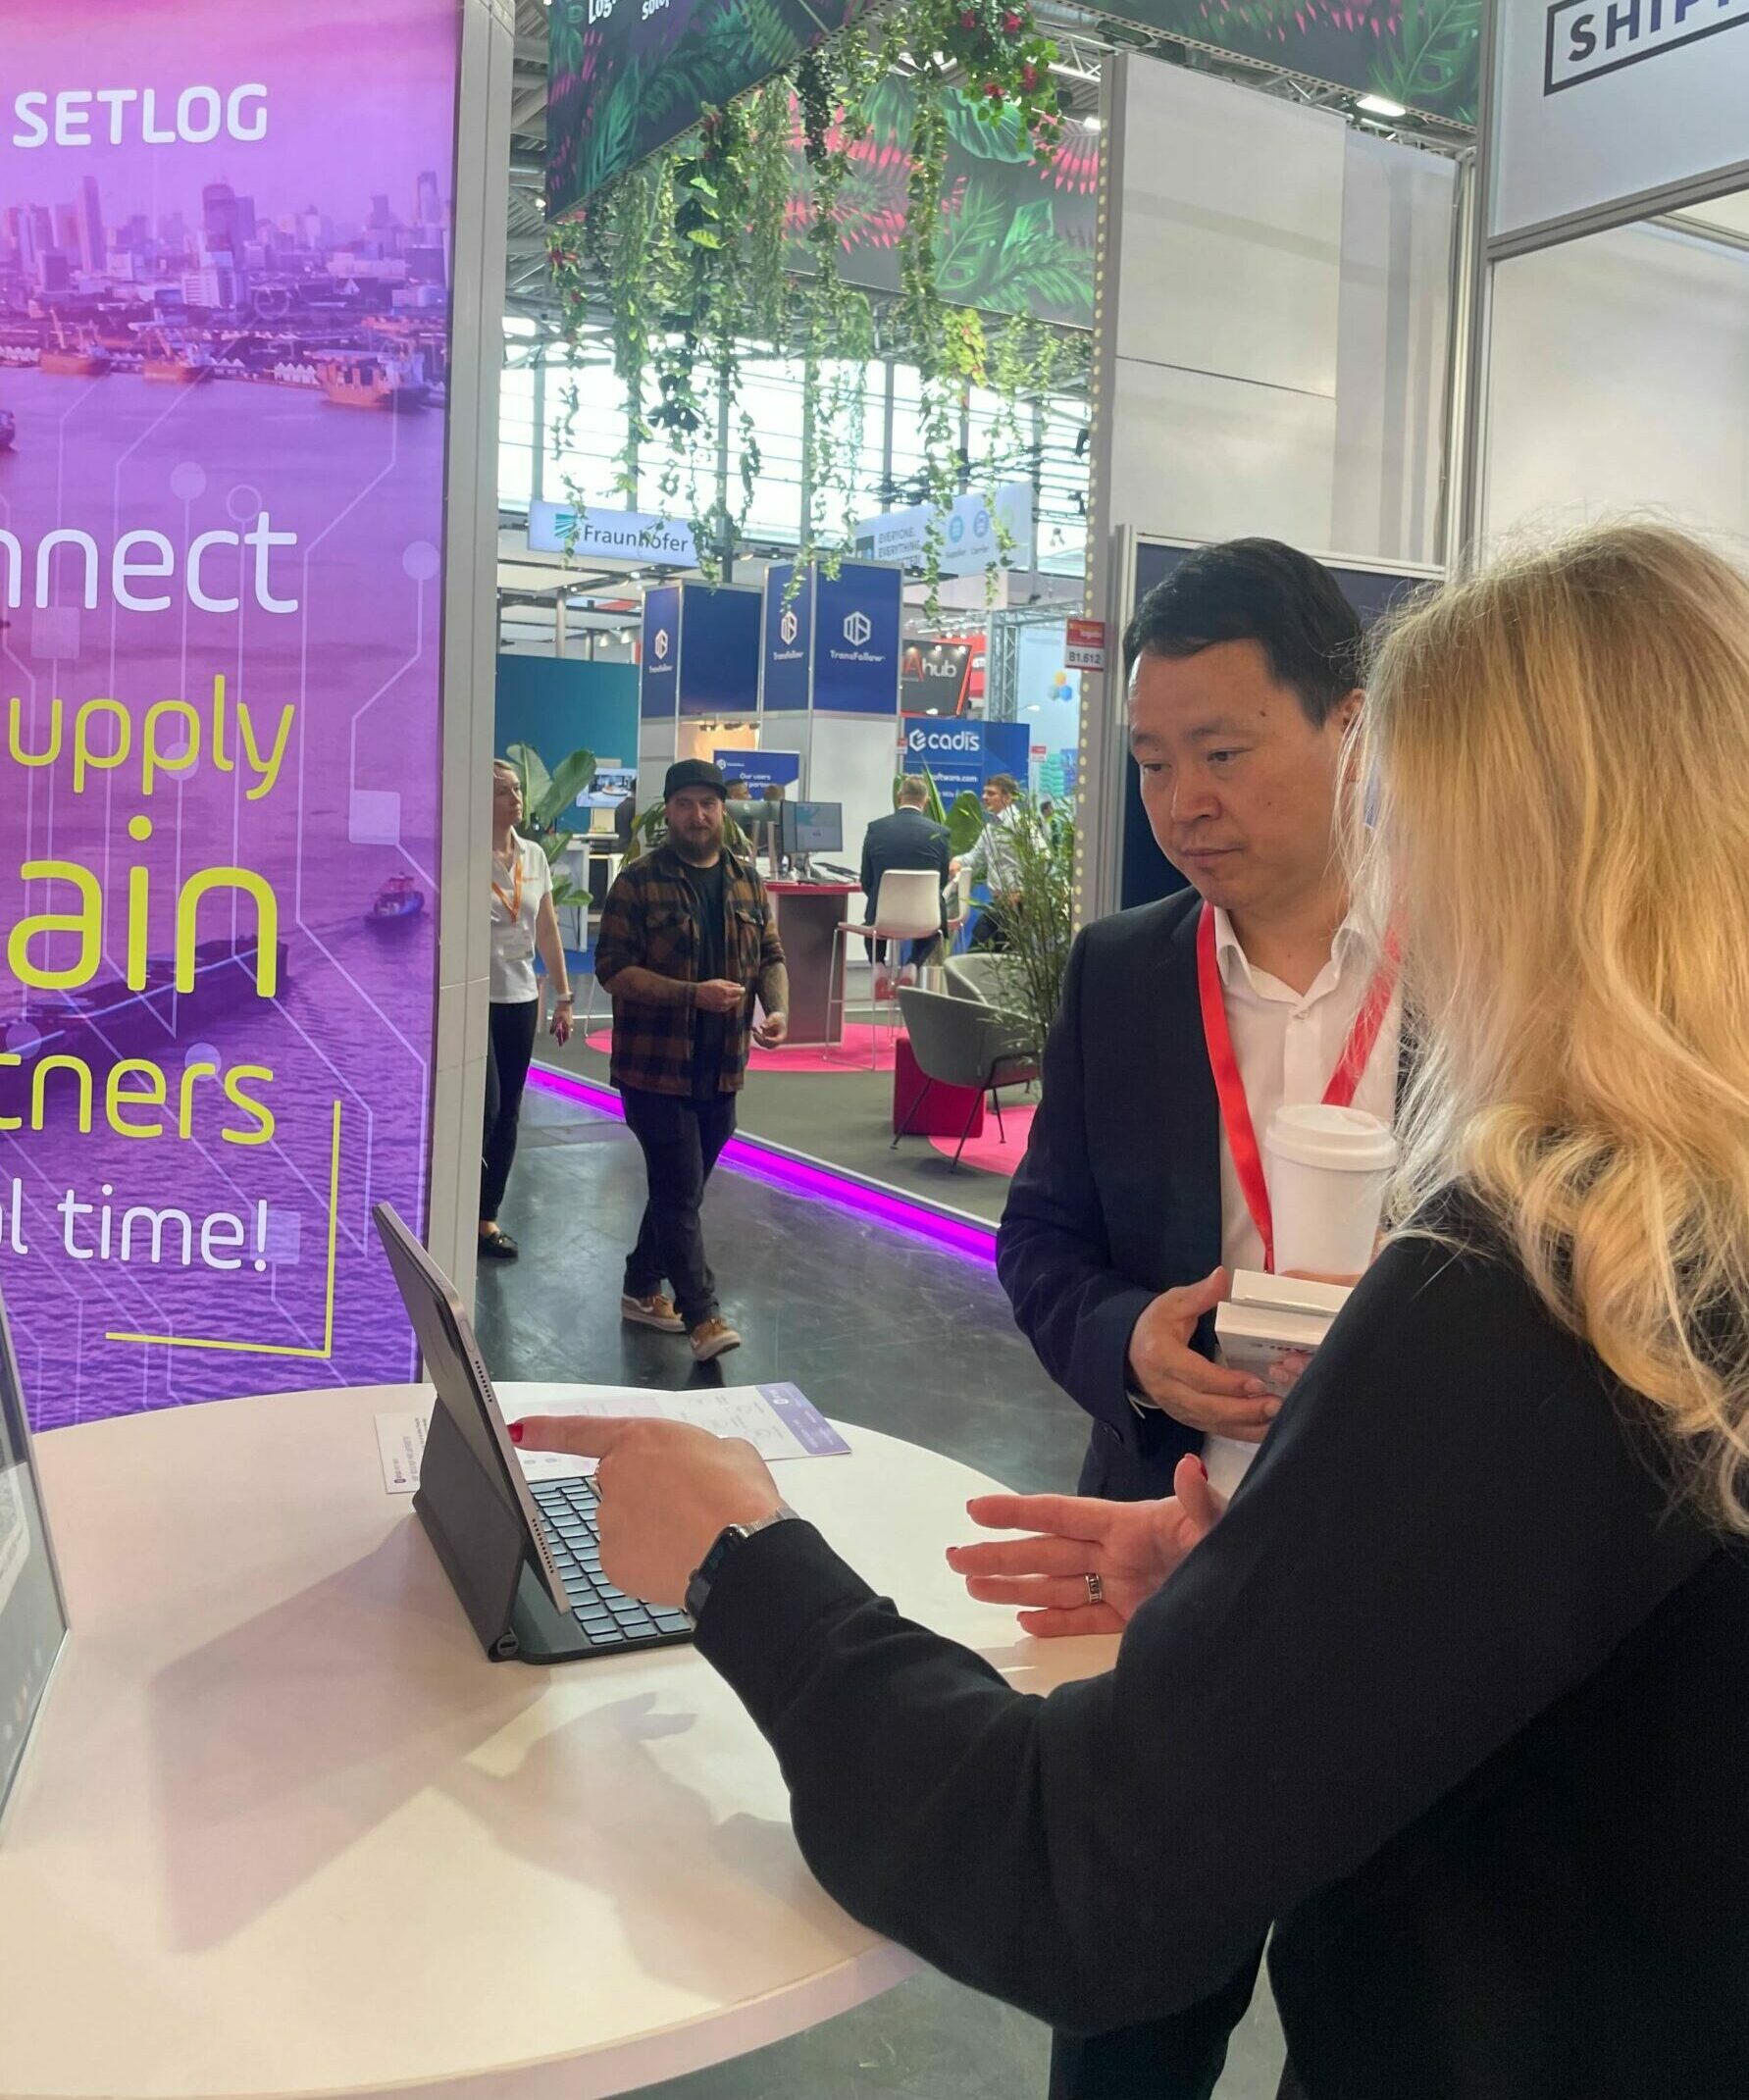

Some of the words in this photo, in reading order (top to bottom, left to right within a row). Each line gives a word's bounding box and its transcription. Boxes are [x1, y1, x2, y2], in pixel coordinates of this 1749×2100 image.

[1568, 0, 1730, 62] SHIP
[12, 83, 268, 148] SETLOG
[584, 525, 688, 552] Fraunhofer
[9, 675, 295, 800] upply
[928, 731, 980, 751] cadis
[8, 815, 278, 999] ain
[57, 1183, 268, 1272] time!
